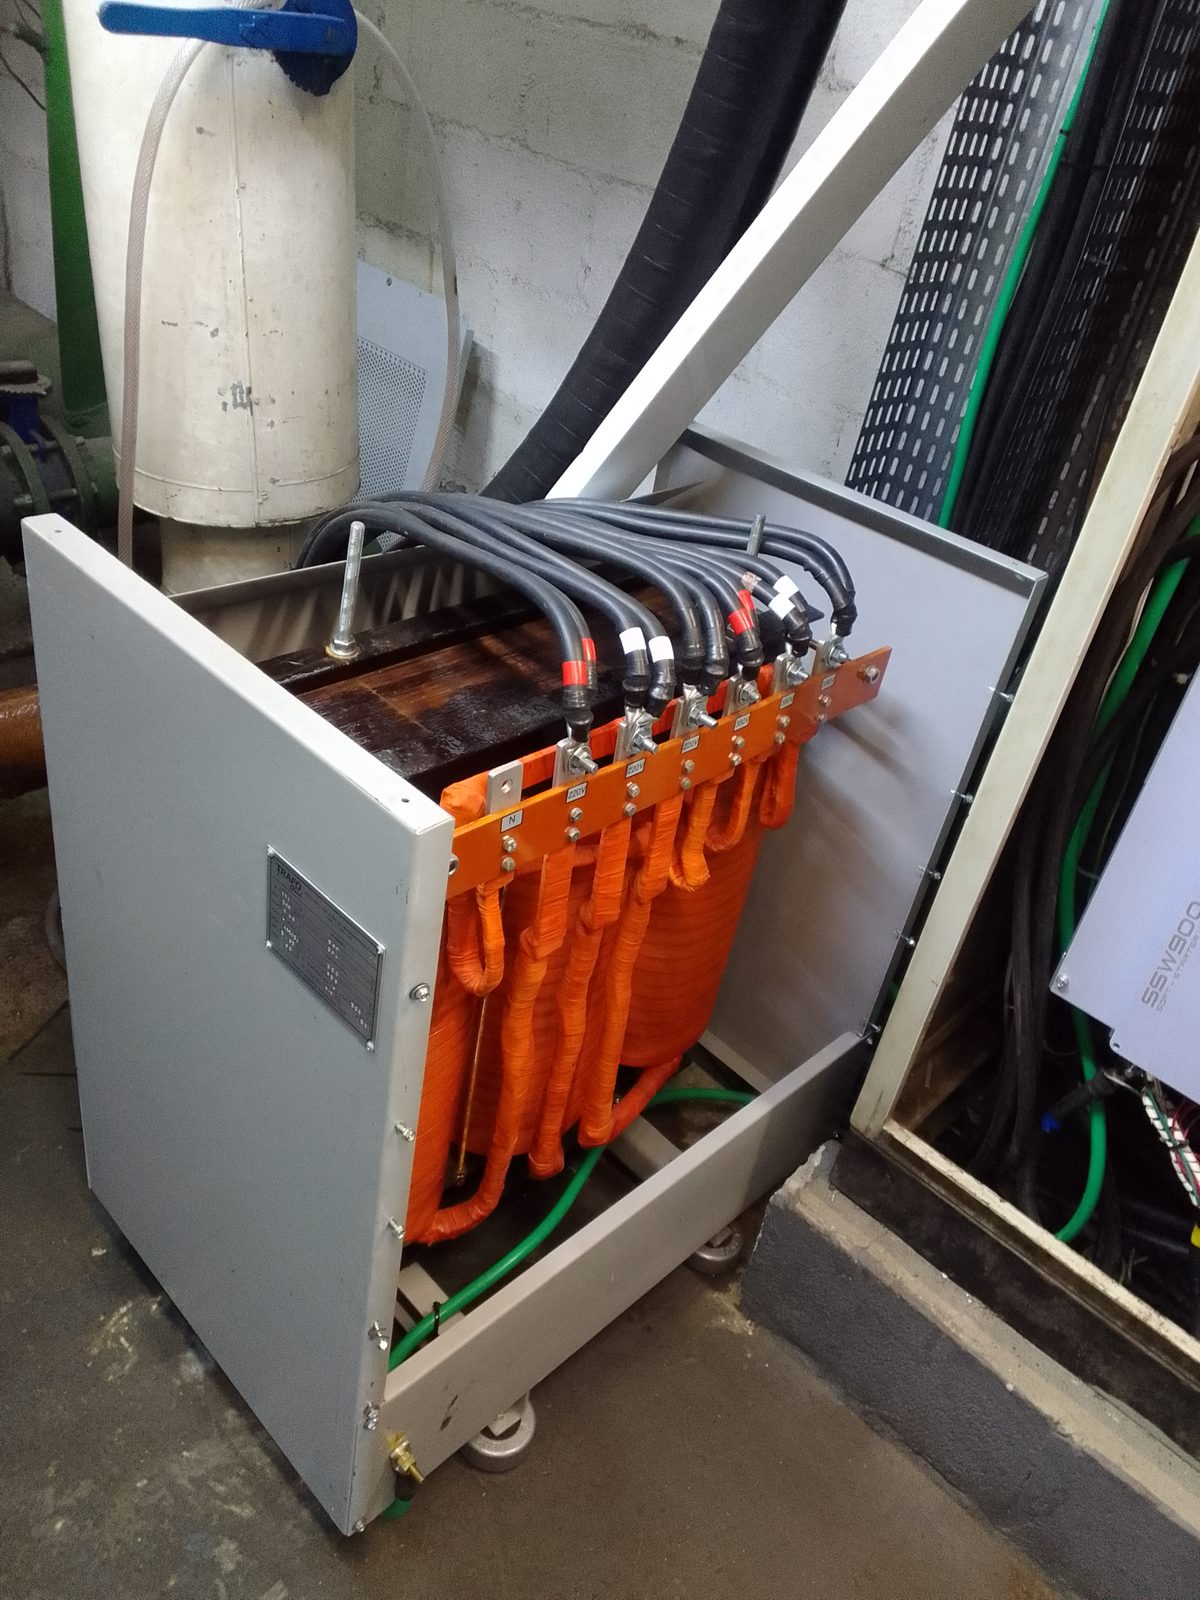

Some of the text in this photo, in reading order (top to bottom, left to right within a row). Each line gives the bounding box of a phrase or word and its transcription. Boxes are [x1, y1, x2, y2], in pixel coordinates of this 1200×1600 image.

[683, 738, 698, 751] 220V
[627, 762, 643, 775] 220V
[568, 786, 585, 800] 220V
[508, 815, 516, 825] N
[276, 864, 302, 891] TRAFO
[1141, 901, 1200, 1008] SSW900
